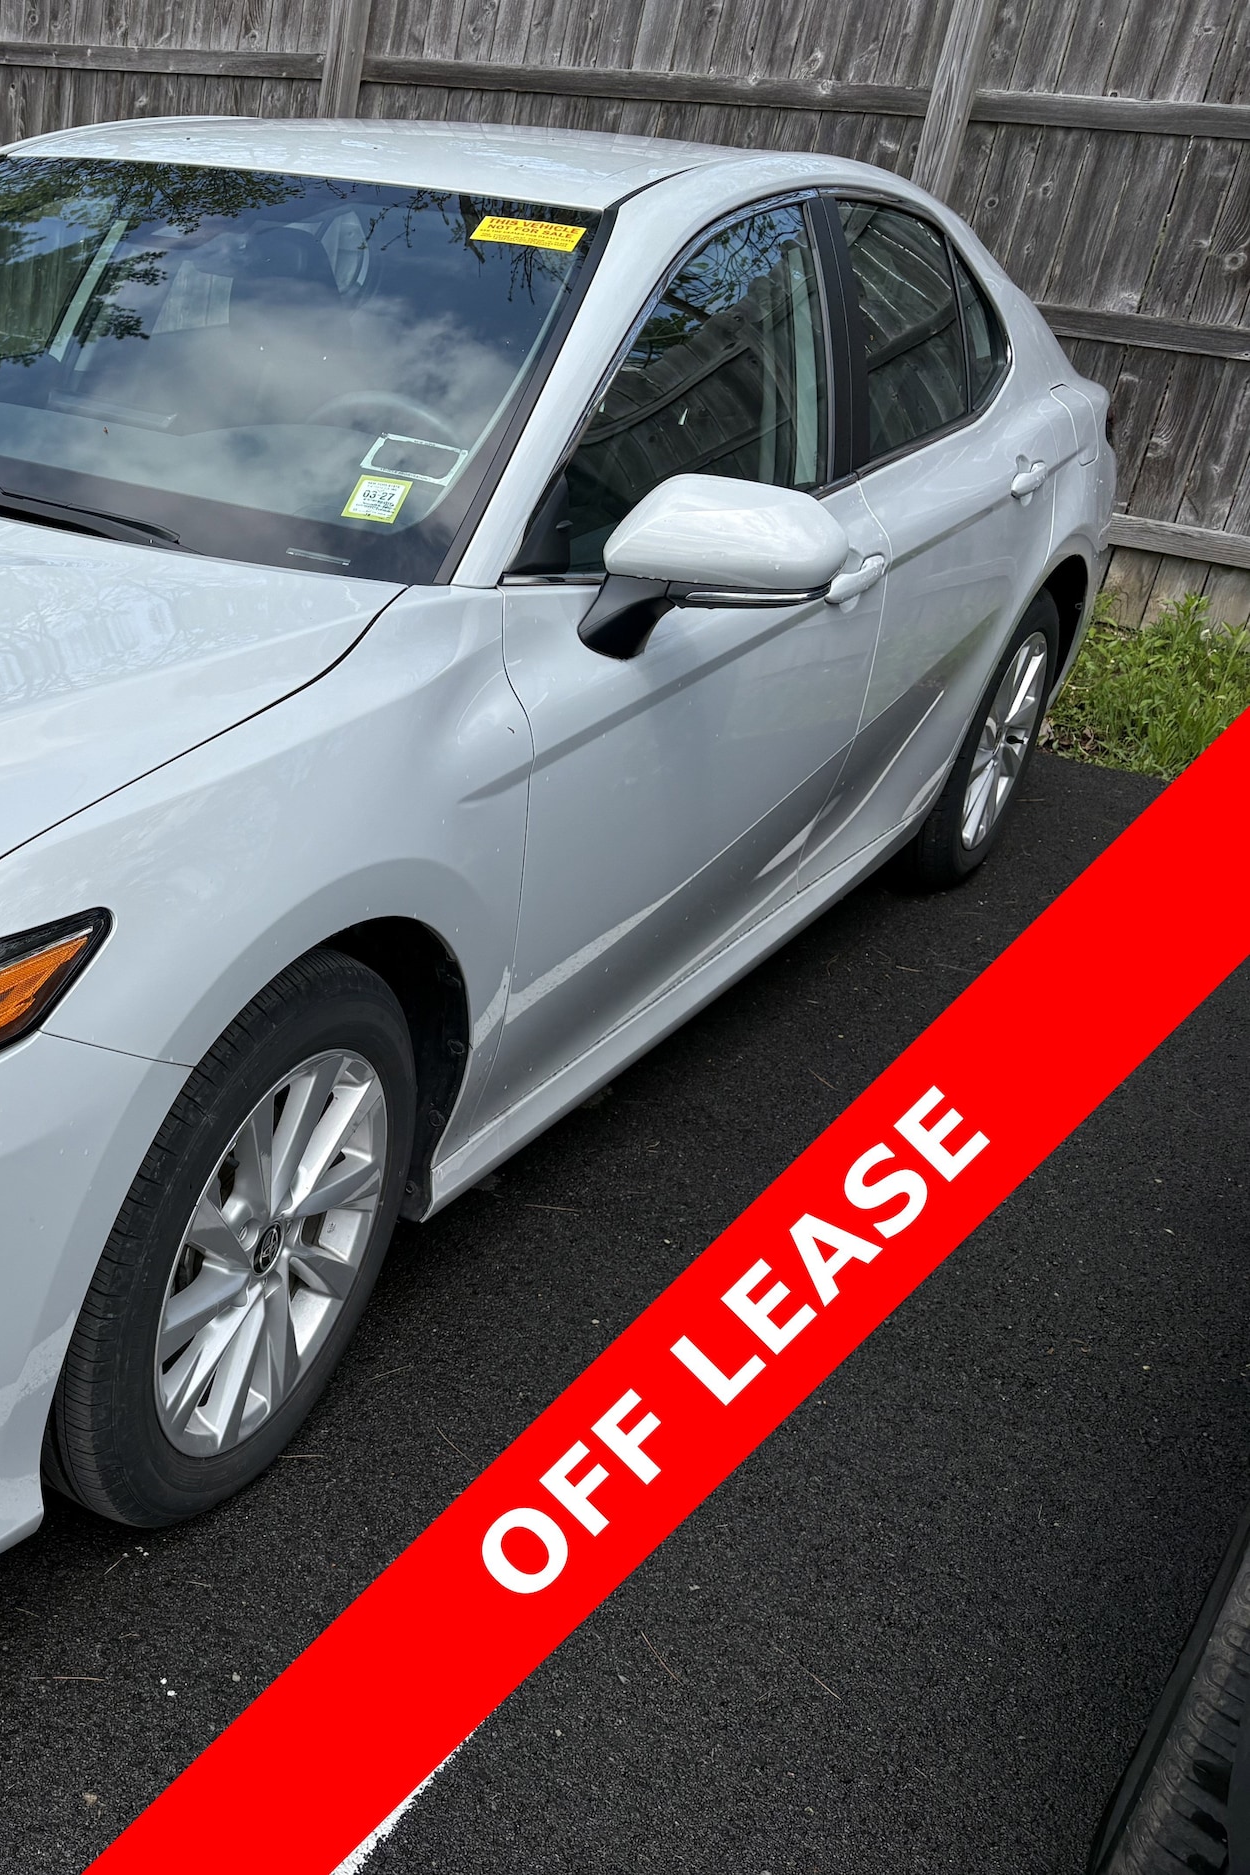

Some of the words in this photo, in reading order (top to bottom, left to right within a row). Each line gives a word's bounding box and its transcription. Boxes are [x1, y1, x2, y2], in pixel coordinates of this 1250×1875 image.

[490, 218, 519, 226] THIS
[523, 221, 579, 234] VEHICLE
[542, 230, 573, 238] SALE
